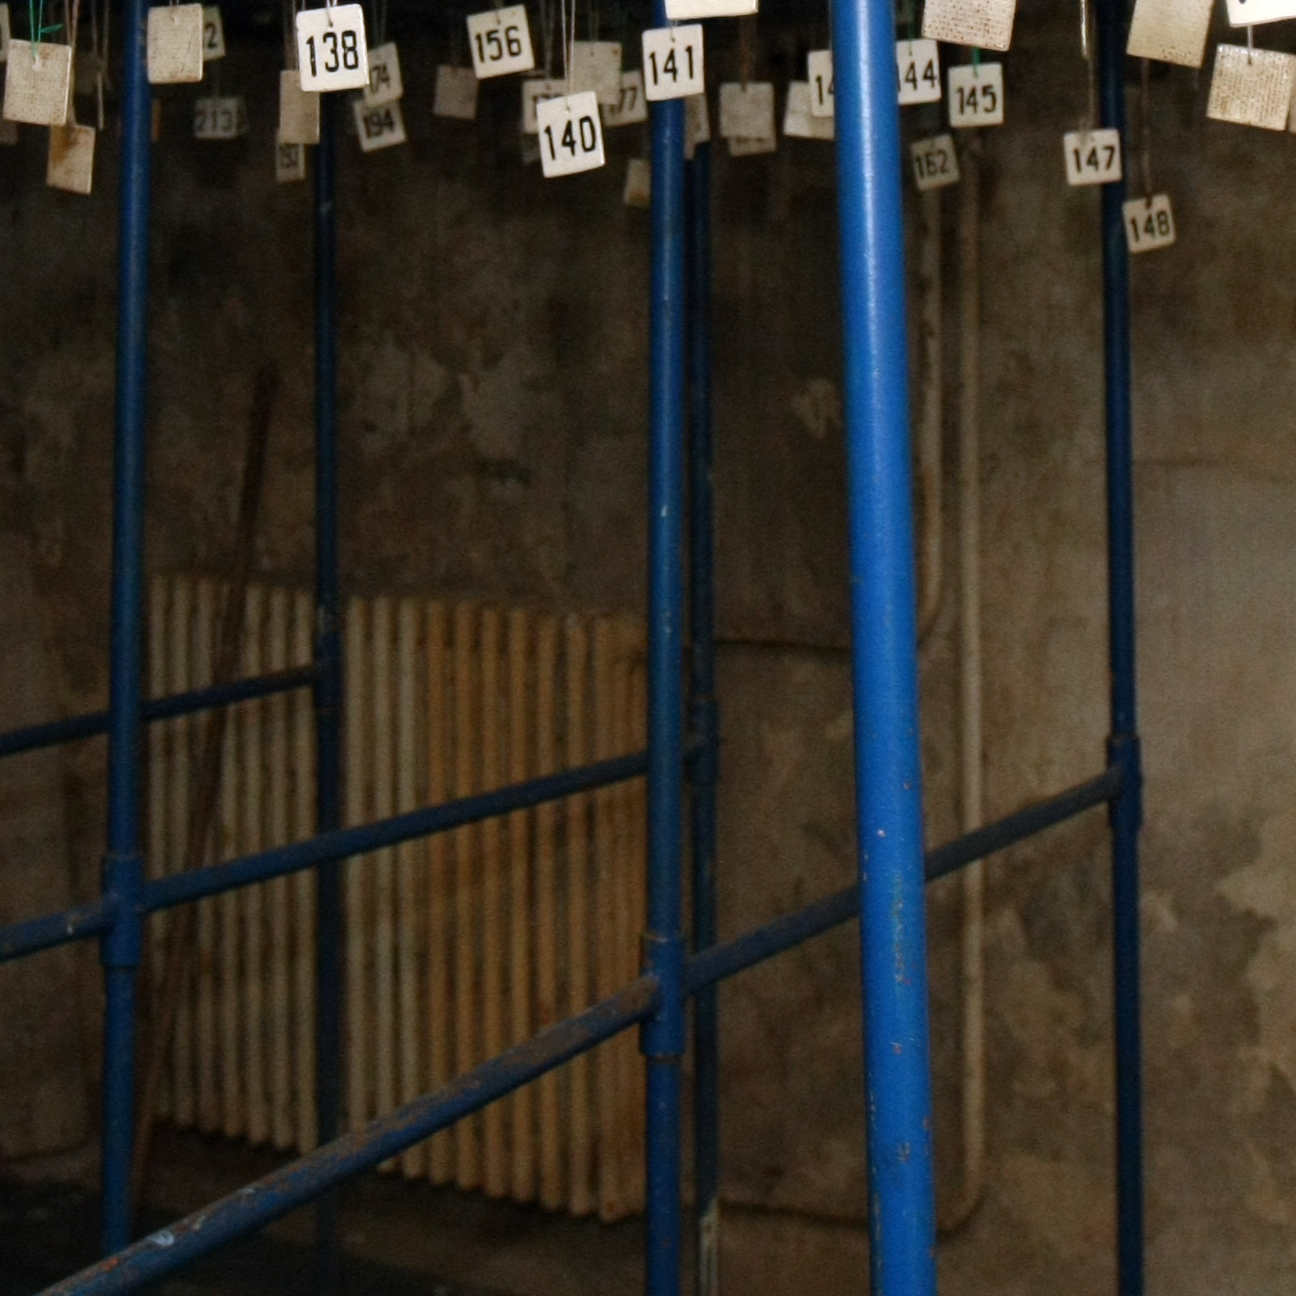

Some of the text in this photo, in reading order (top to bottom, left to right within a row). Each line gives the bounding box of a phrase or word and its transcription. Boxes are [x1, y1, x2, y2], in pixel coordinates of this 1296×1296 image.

[305, 30, 361, 77] 138
[475, 25, 522, 63] 156
[650, 45, 695, 86] 141
[956, 84, 997, 115] 145
[363, 108, 394, 139] 194
[544, 115, 596, 162] 140
[1072, 144, 1116, 174] 147
[1129, 209, 1171, 241] 148
